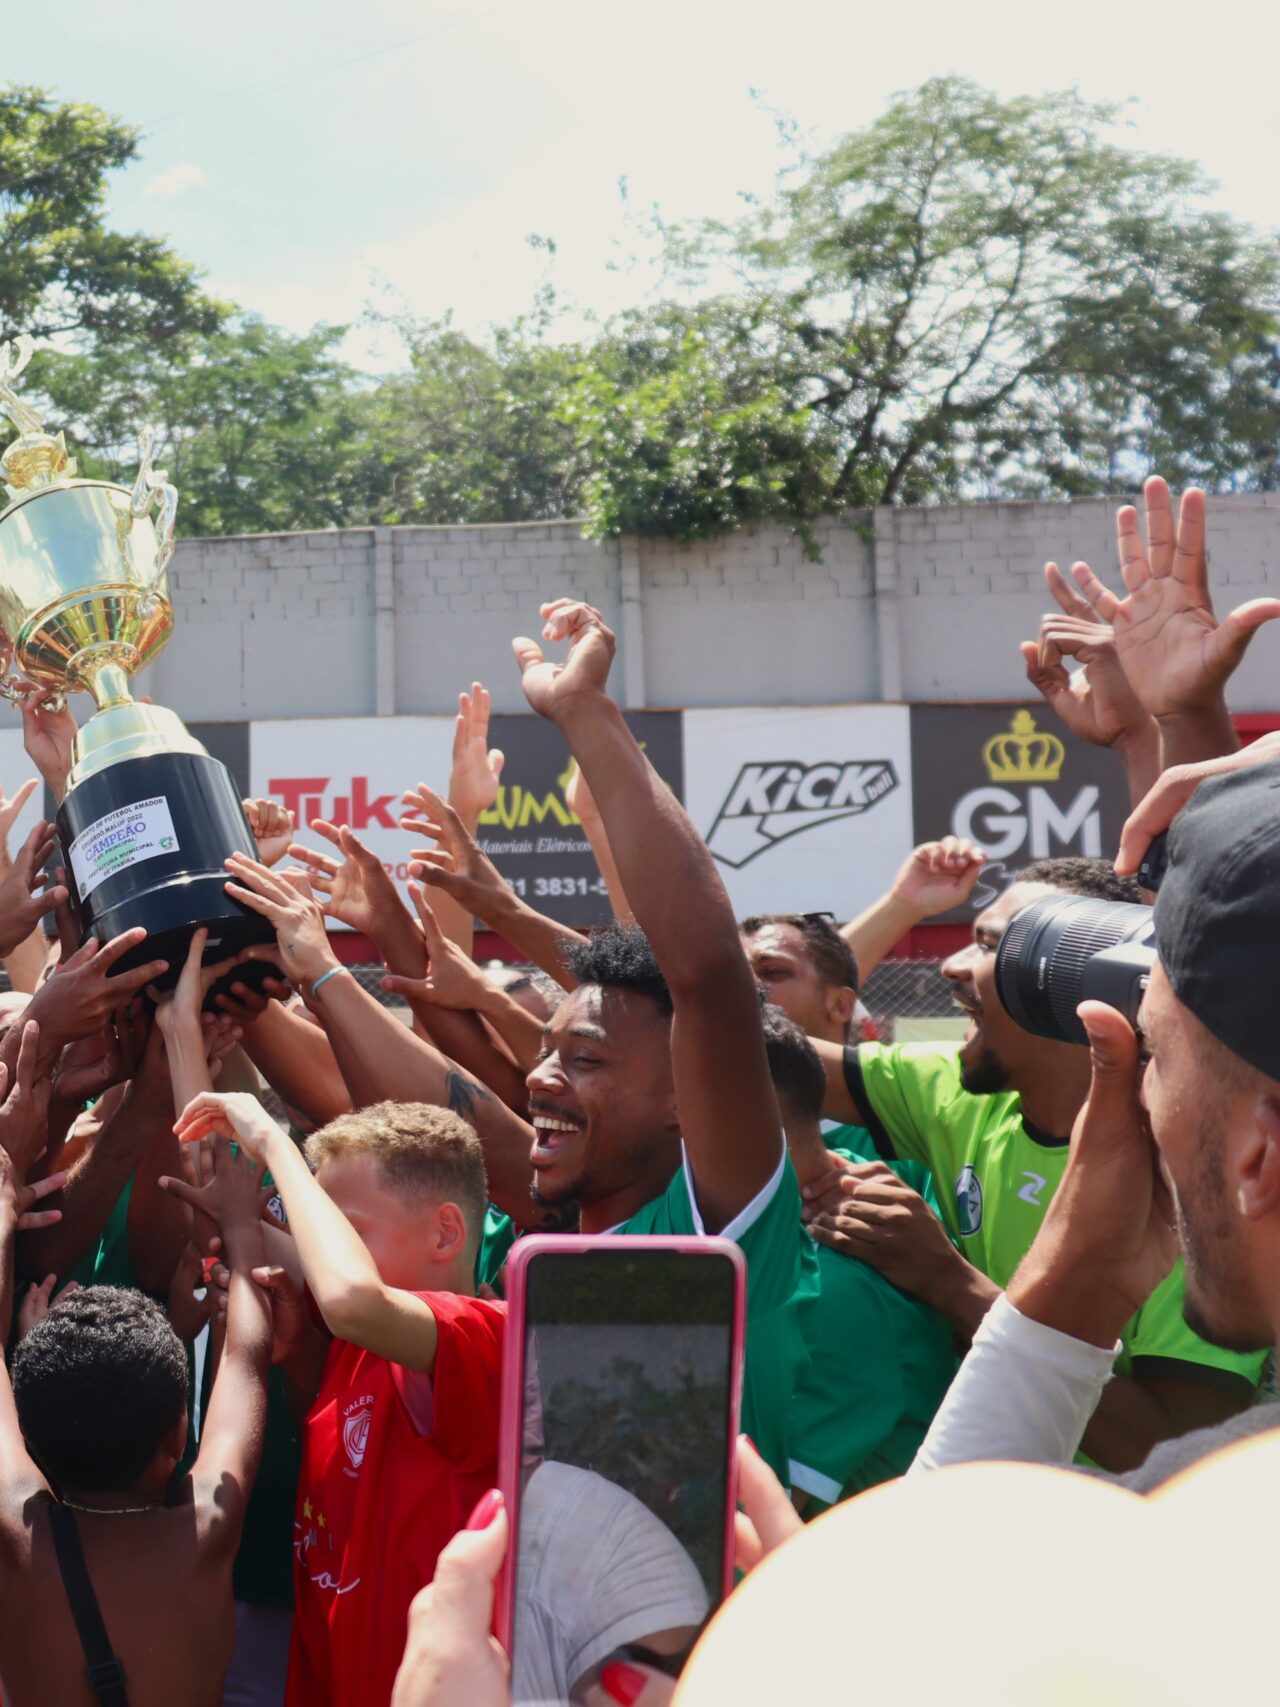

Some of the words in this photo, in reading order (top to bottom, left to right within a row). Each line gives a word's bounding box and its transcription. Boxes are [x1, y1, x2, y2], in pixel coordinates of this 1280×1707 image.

[104, 807, 133, 825] FUTEBOL
[134, 798, 163, 811] AMADOR
[127, 813, 143, 824] 2022
[952, 786, 1102, 860] GM
[85, 821, 146, 861] CAMPEÃO
[118, 841, 154, 858] MUNICIPAL
[536, 835, 593, 853] Elétricos
